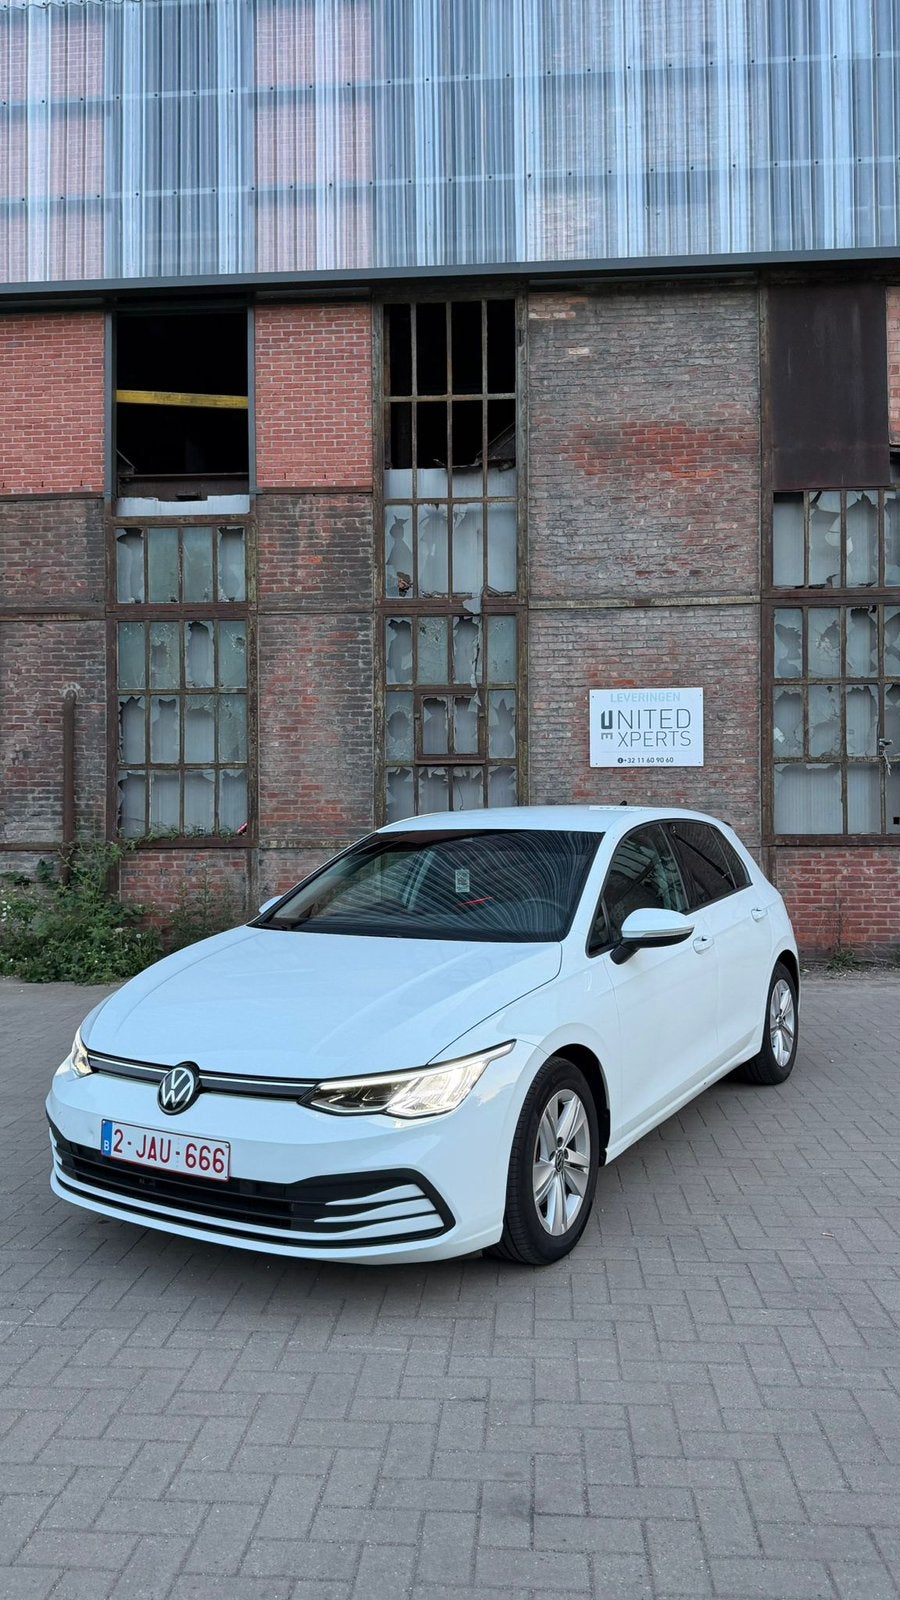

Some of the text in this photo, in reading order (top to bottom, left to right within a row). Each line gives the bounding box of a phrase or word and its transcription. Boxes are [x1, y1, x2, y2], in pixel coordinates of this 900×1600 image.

[610, 692, 681, 702] LEVERINGEN
[601, 709, 691, 729] UNITED
[104, 1141, 110, 1151] B
[113, 1129, 225, 1174] 2-JAU-666
